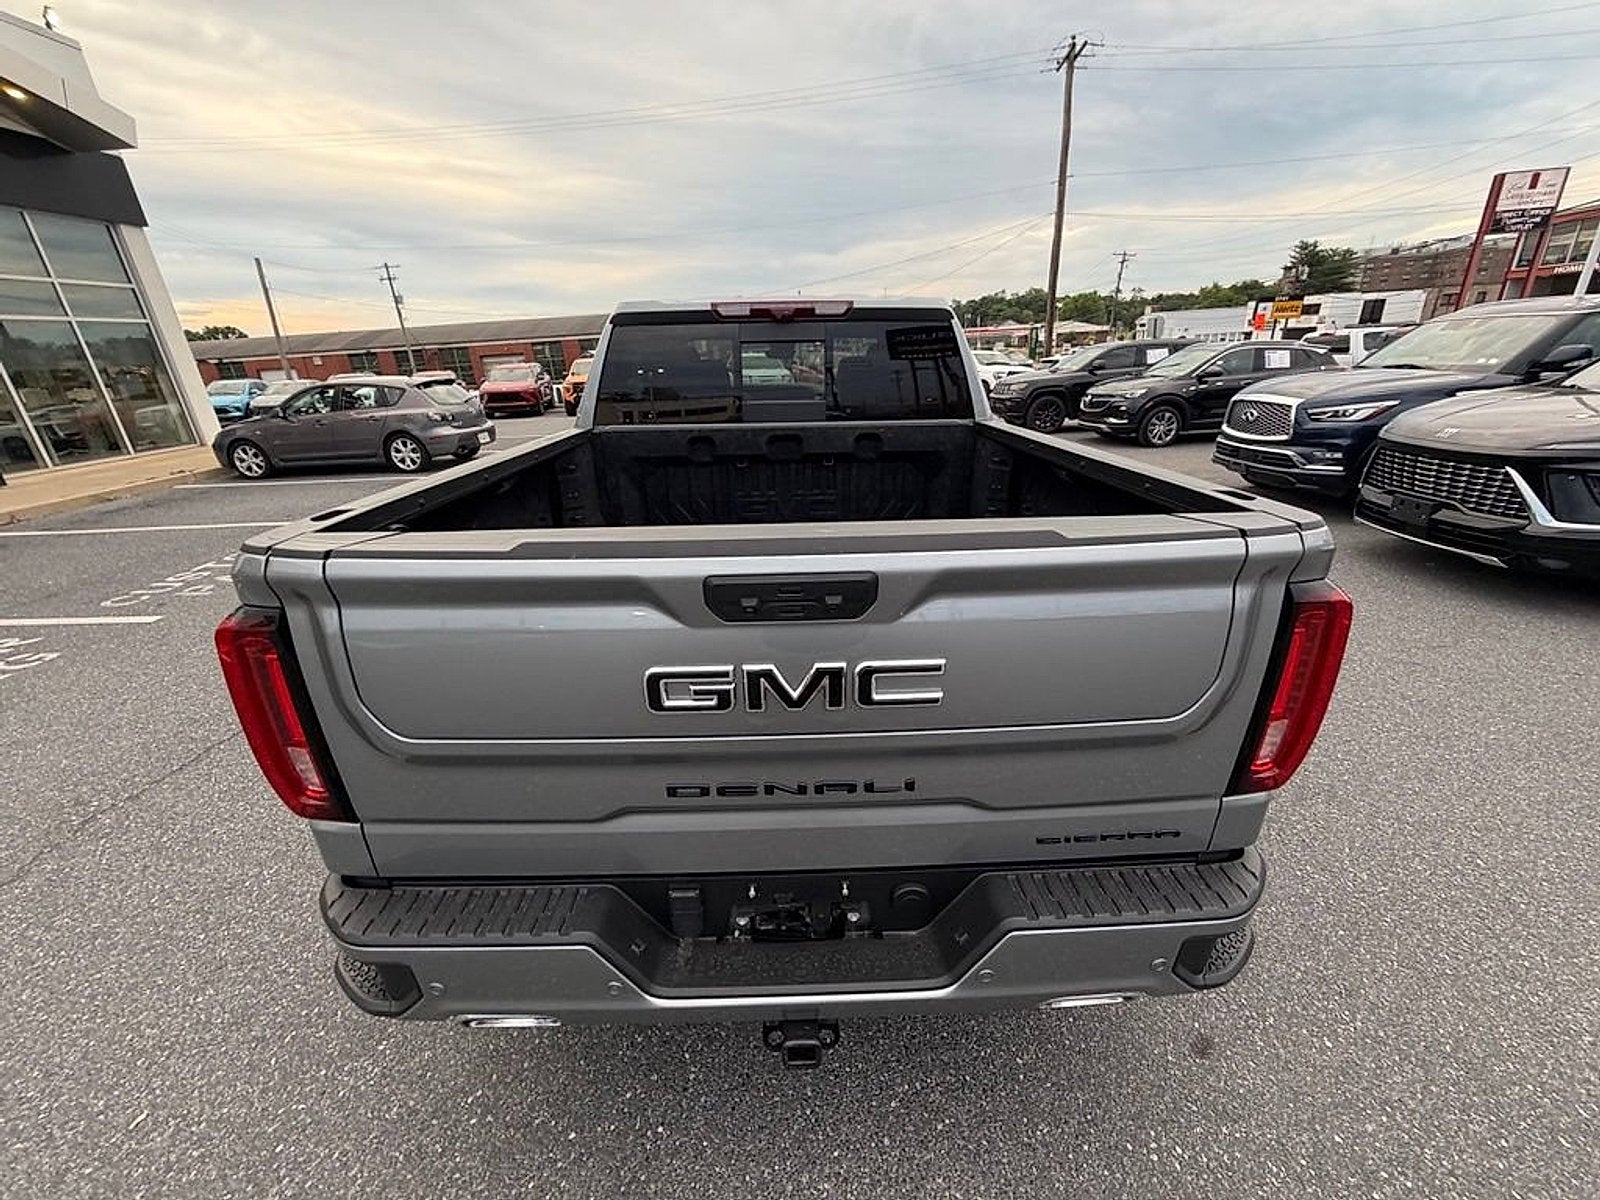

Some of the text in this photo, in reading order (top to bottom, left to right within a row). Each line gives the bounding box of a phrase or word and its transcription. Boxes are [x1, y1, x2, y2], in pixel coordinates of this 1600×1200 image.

[1274, 303, 1301, 313] Hertz
[645, 658, 947, 713] GMC
[665, 777, 916, 798] DENALI
[1035, 830, 1181, 845] SIERRA
